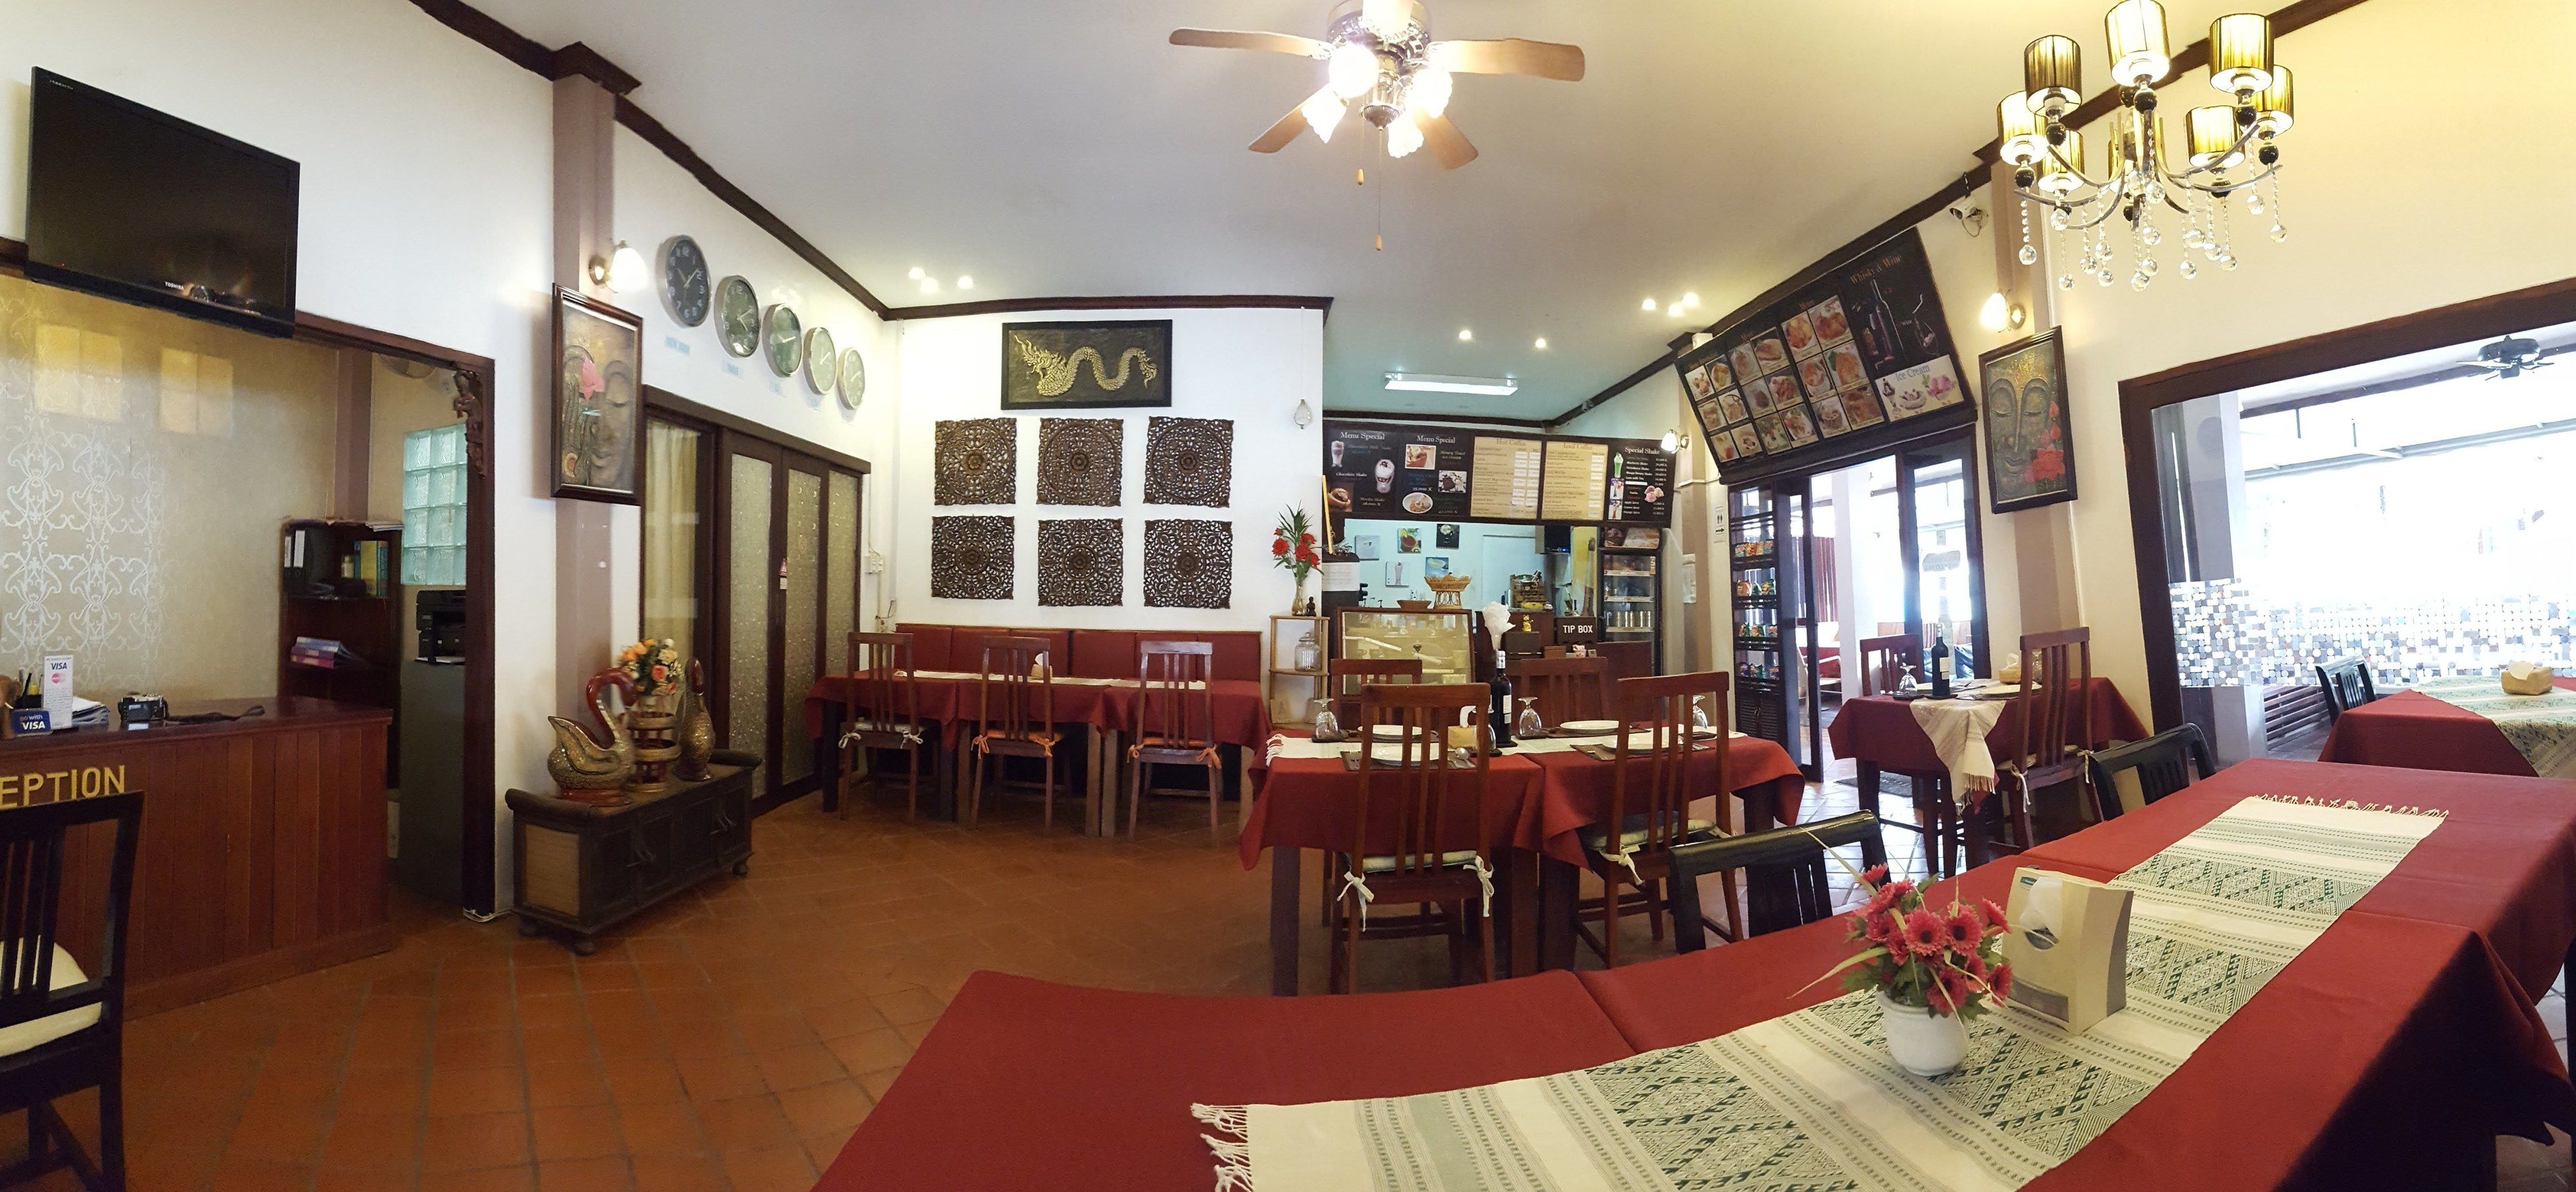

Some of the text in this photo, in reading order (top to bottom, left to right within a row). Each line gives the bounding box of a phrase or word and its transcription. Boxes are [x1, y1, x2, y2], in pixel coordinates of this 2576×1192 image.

[164, 281, 184, 290] TOSHIBA
[1895, 364, 1931, 382] Ice Cream
[1340, 431, 1385, 441] Menu Special
[1509, 439, 1526, 447] Coffee
[1562, 625, 1593, 633] TIP BOX
[50, 662, 68, 670] VISA
[21, 720, 46, 730] VISA
[0, 765, 125, 809] EPTION
